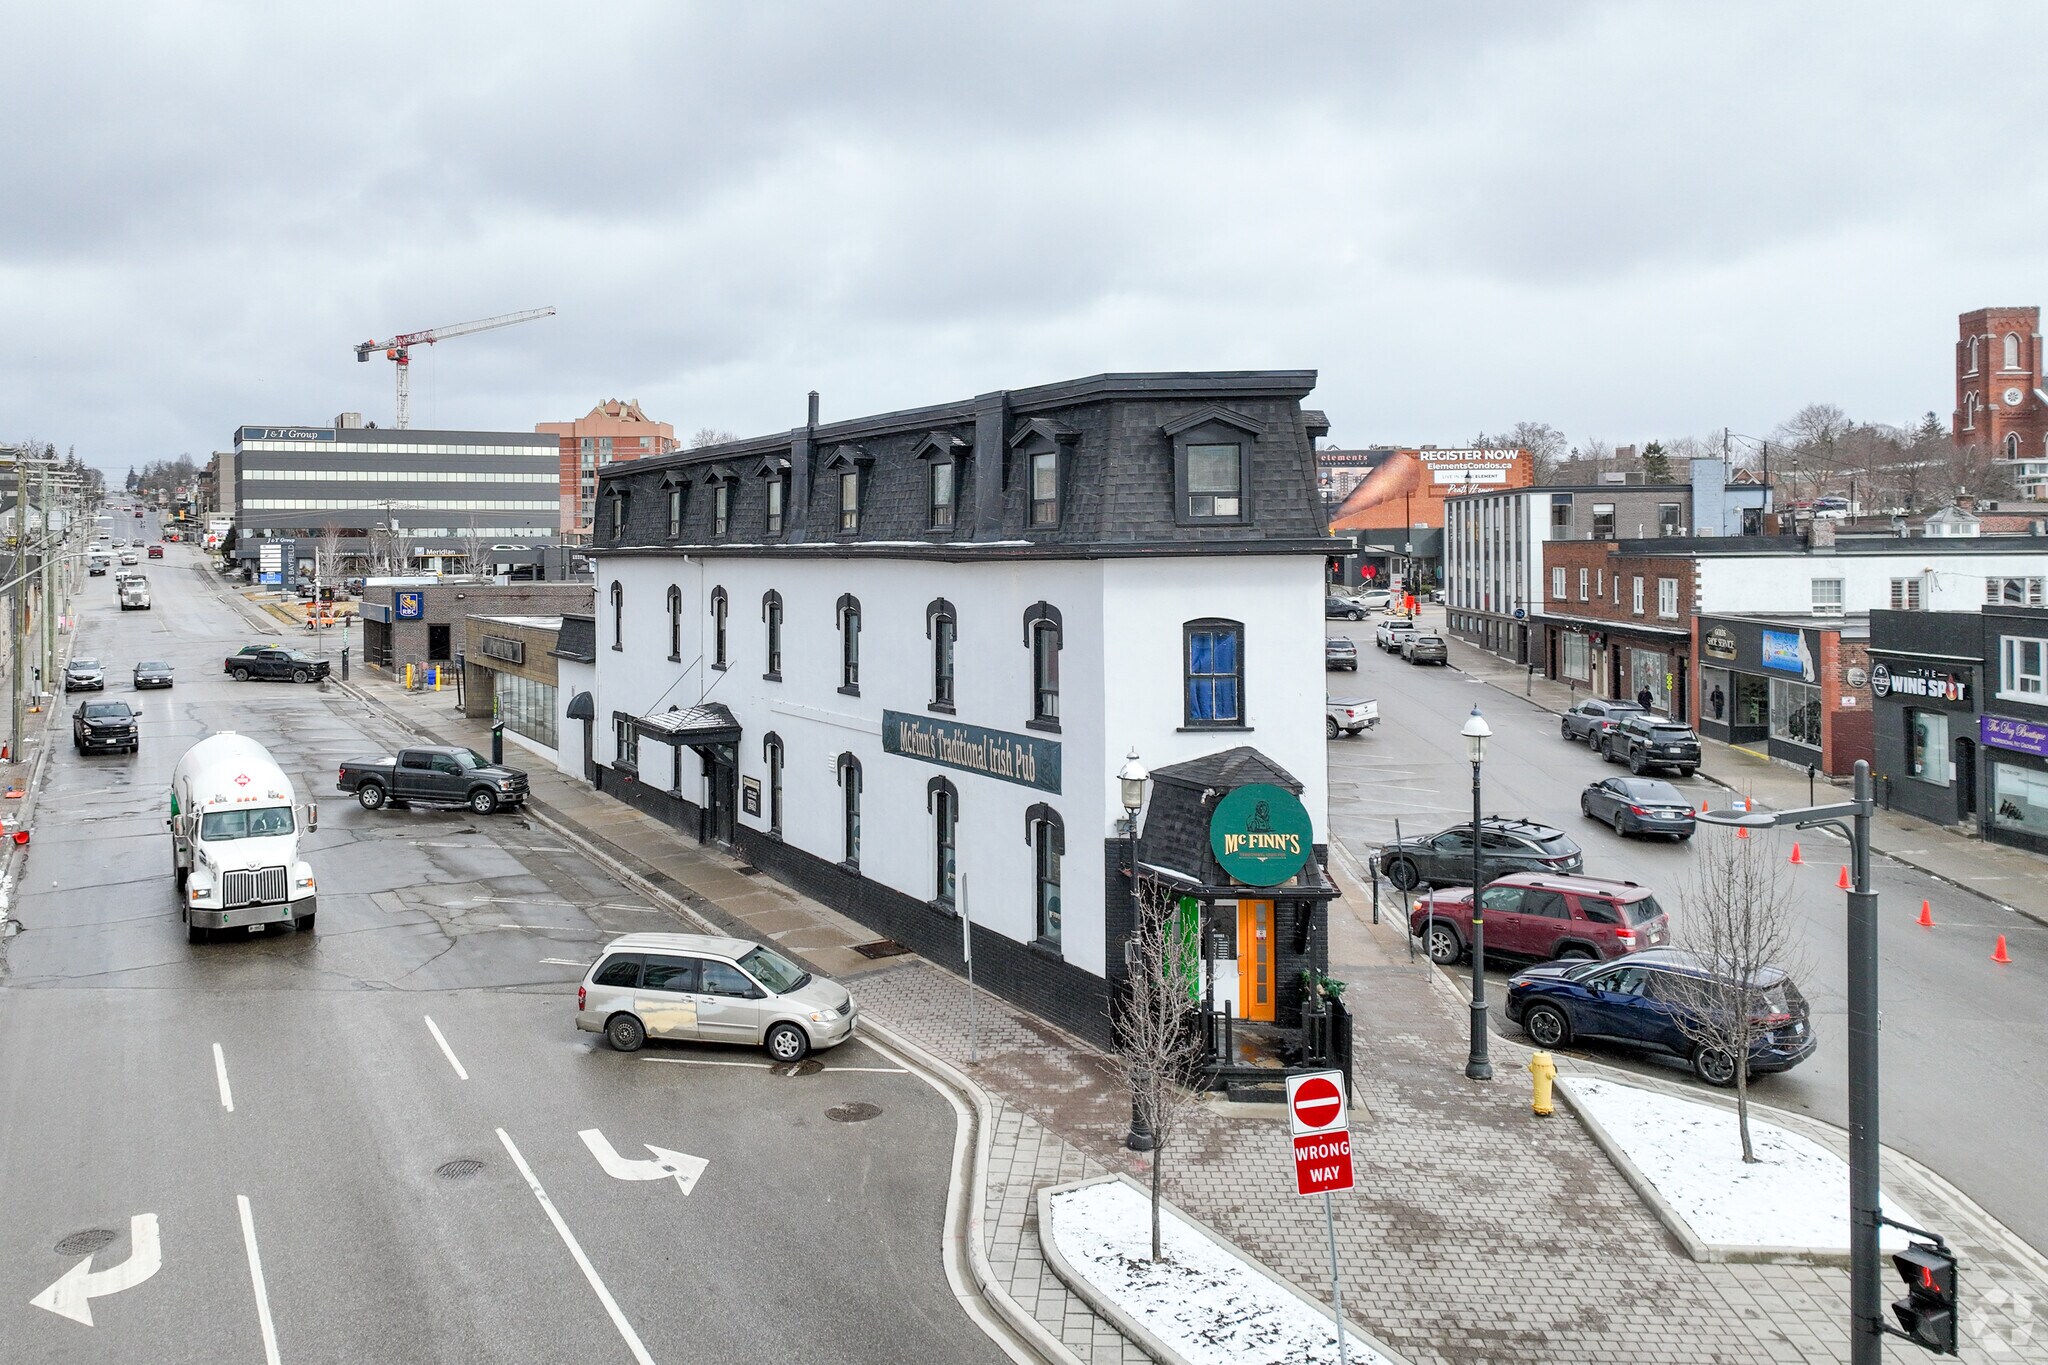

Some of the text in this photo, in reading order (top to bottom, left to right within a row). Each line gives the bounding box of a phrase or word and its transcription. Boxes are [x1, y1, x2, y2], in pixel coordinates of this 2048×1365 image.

[261, 429, 269, 439] J
[278, 429, 287, 438] T
[288, 430, 318, 440] Group
[1420, 449, 1519, 461] REGISTER NOW
[1427, 462, 1512, 470] ElementsCondos.ca
[287, 544, 295, 575] BAYFIELD
[1918, 669, 1937, 677] THE
[1891, 675, 1966, 701] WING SPOT
[1987, 718, 2000, 732] The
[900, 721, 1036, 783] McFinn's Traditional Irish Pub
[1295, 1141, 1350, 1162] WRONG
[1309, 1165, 1340, 1183] WAY
